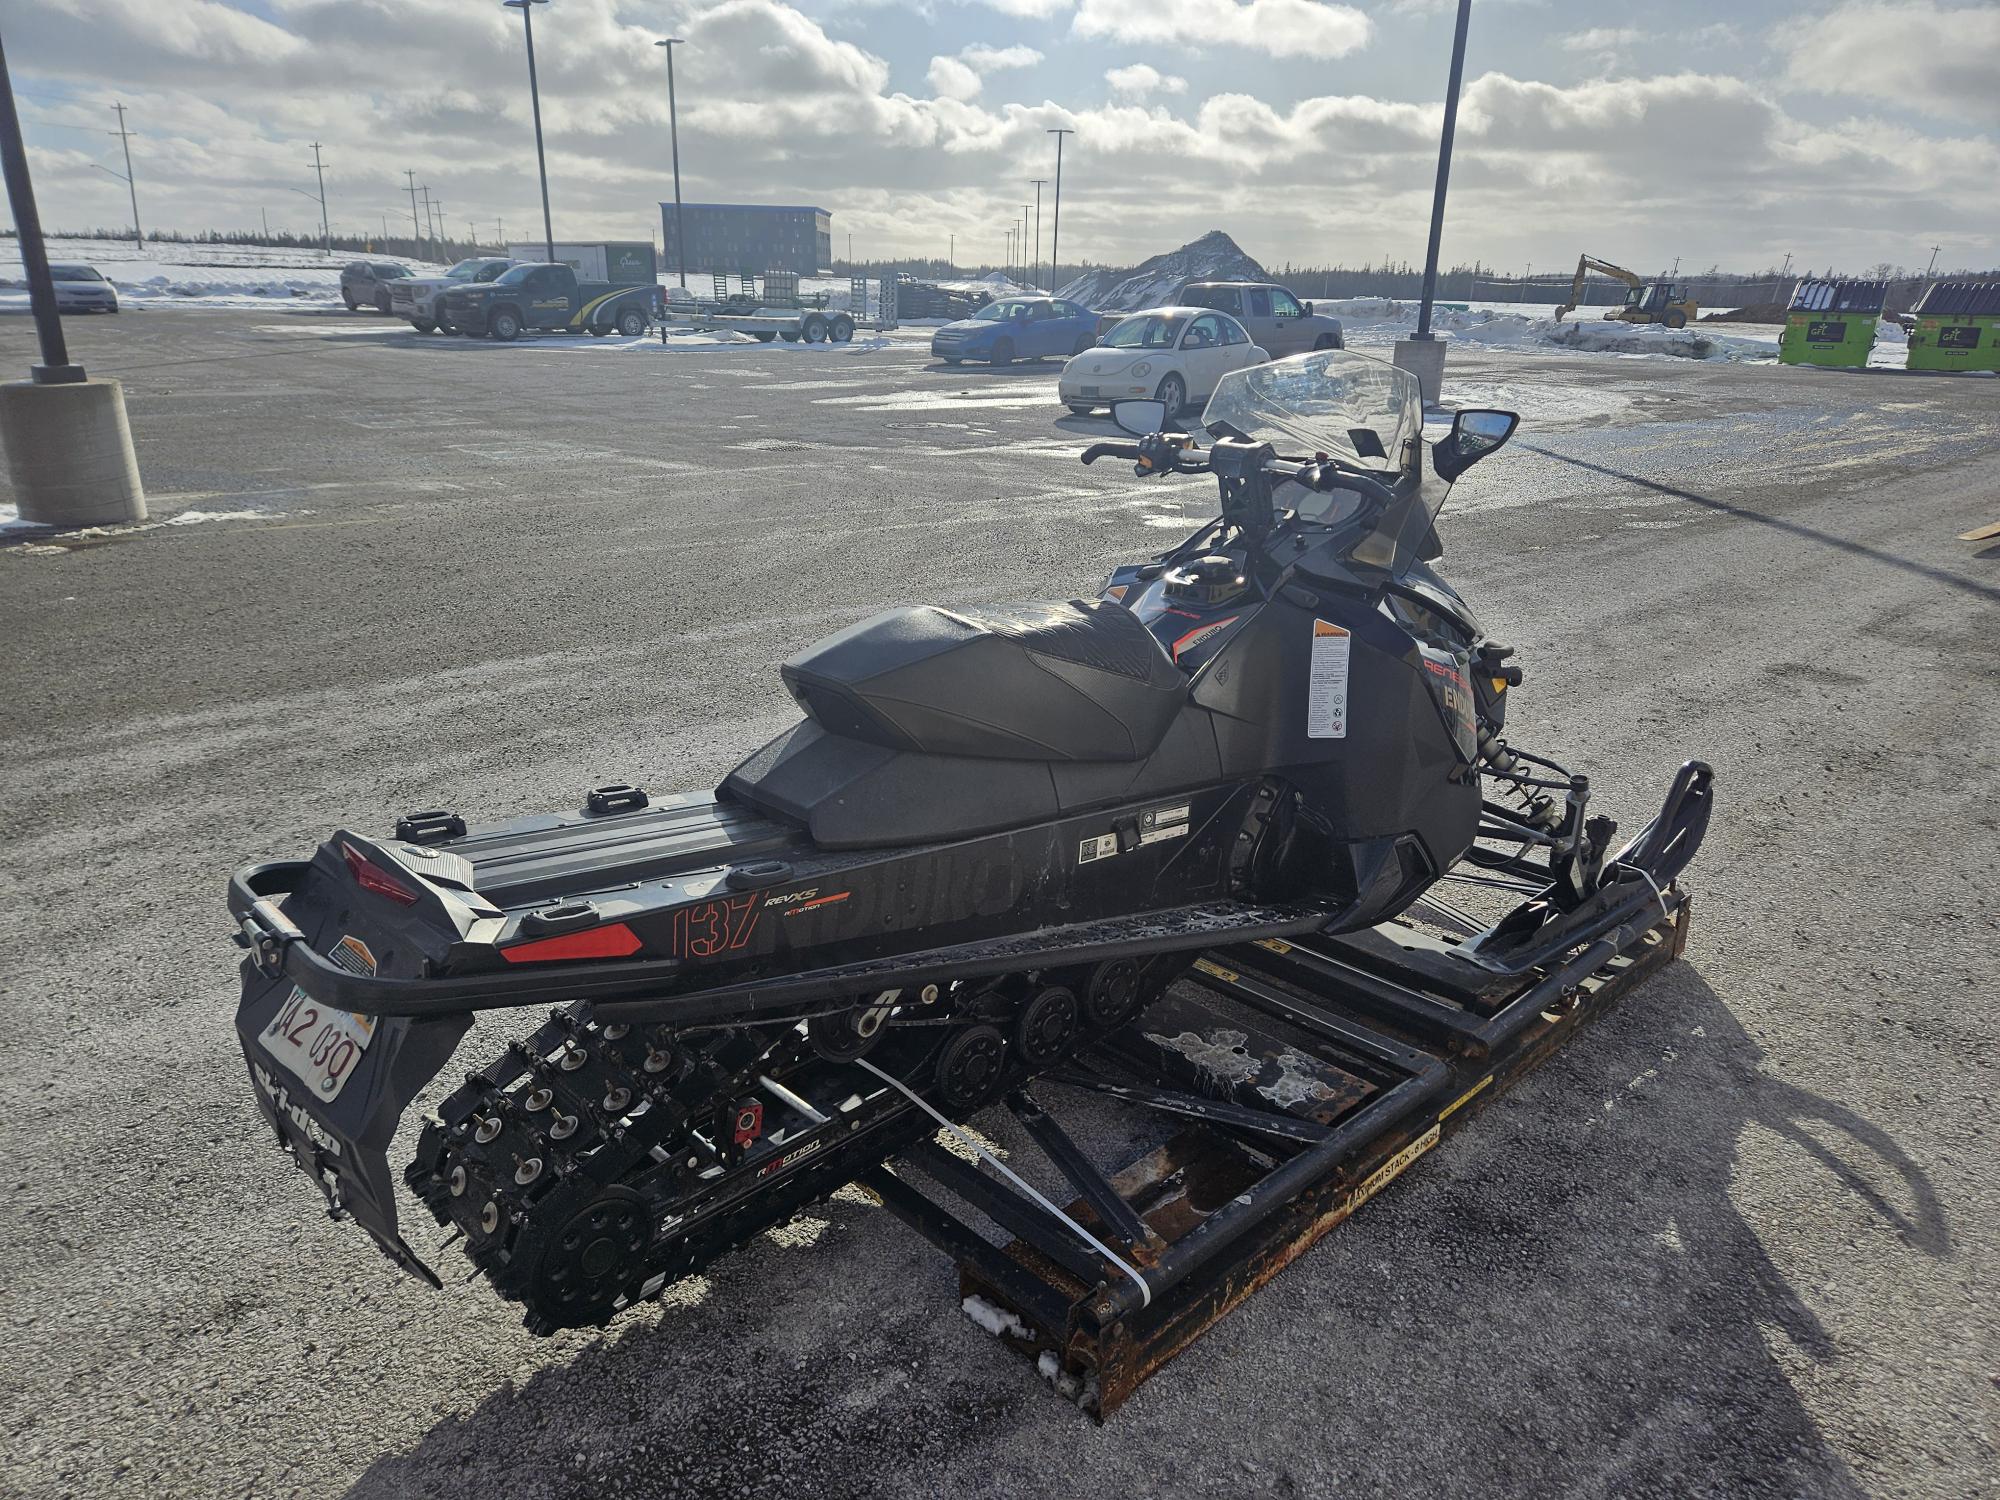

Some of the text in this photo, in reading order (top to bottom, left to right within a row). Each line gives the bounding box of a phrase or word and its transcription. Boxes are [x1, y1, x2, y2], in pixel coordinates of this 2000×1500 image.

[673, 890, 769, 959] 137
[309, 1023, 355, 1078] 030
[1385, 1151, 1411, 1178] STACK
[1414, 1143, 1420, 1154] 6
[1420, 1129, 1439, 1148] HIGH
